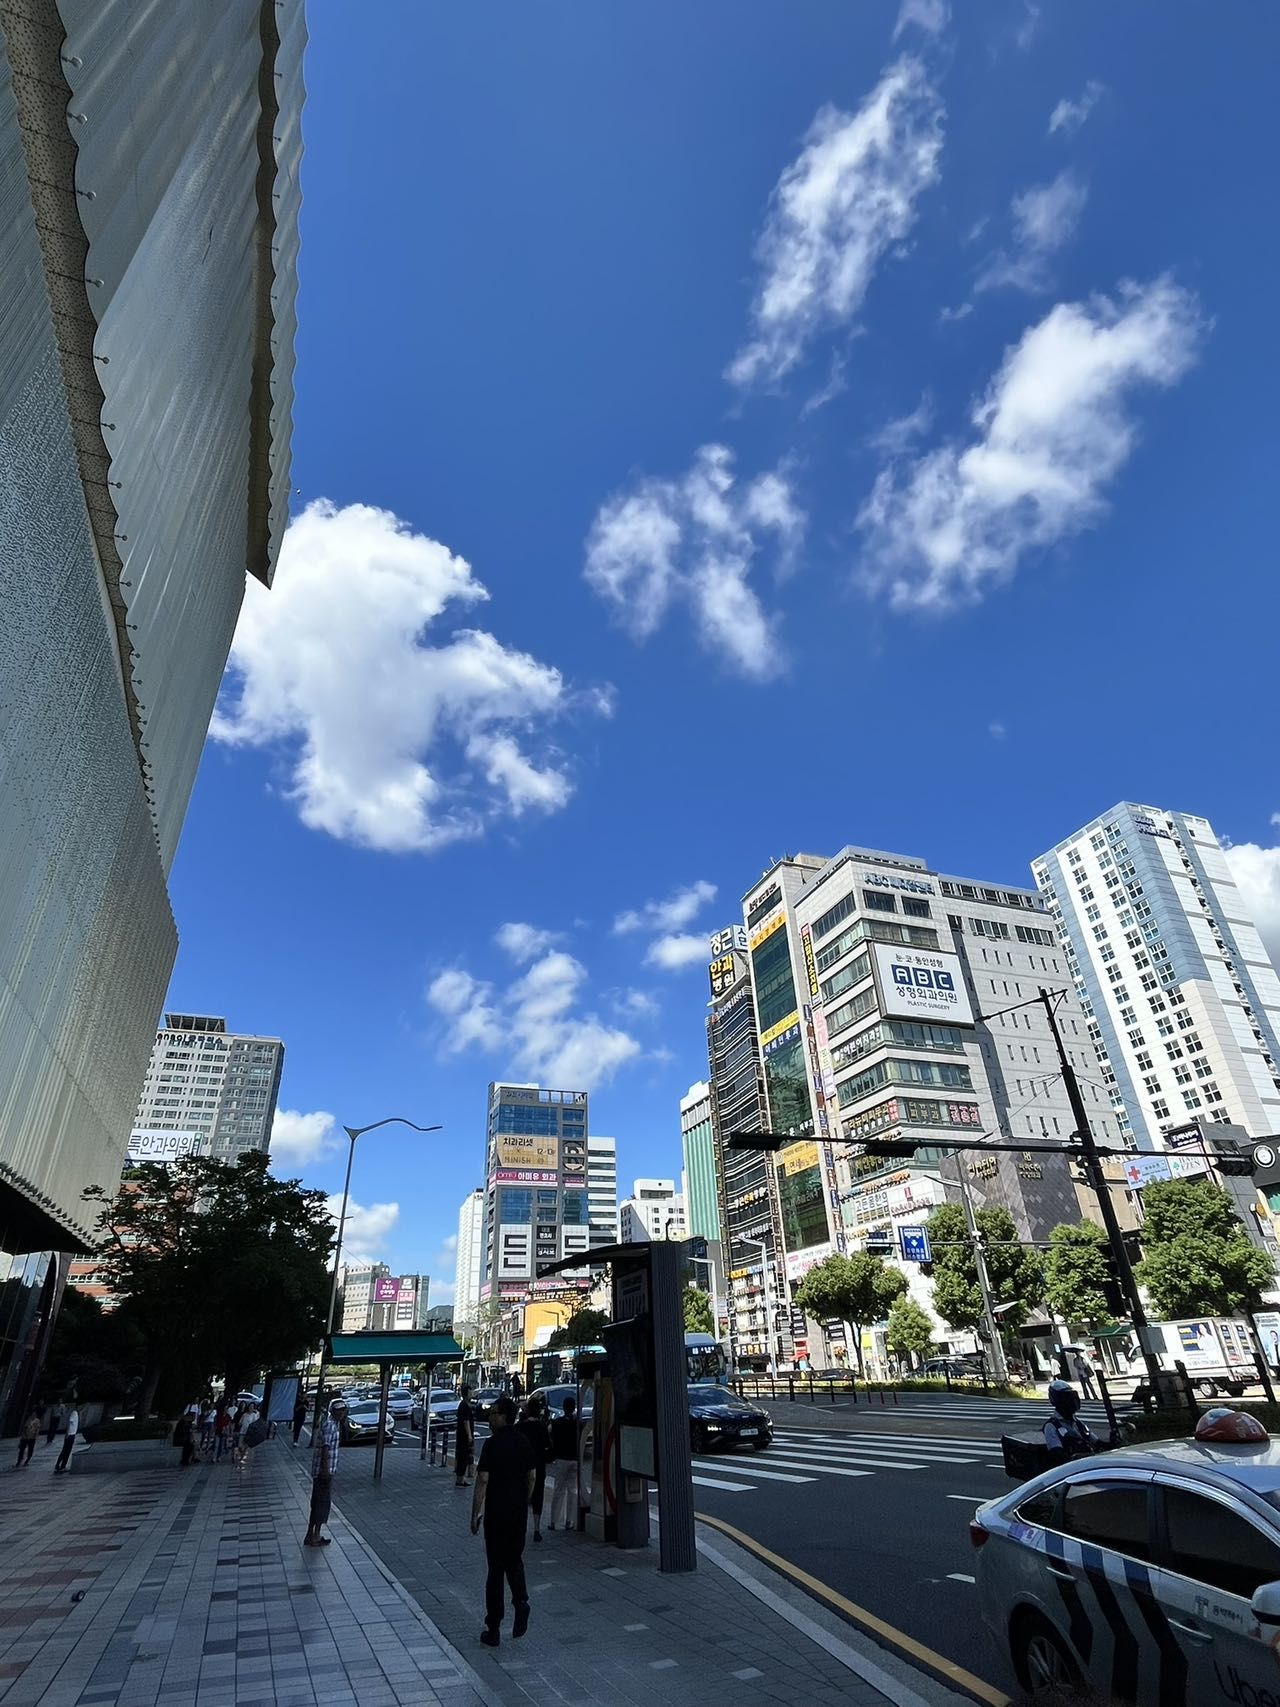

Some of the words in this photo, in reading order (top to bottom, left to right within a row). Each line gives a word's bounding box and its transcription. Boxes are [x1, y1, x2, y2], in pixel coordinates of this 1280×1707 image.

[711, 927, 733, 955] 정근
[711, 953, 733, 979] 안과
[713, 971, 734, 991] 병원
[896, 967, 951, 988] ABC
[895, 985, 958, 1004] 성형외과의원
[907, 1000, 927, 1009] PLASTIC
[928, 1002, 950, 1010] SURGERY
[503, 1137, 533, 1146] 치과리셋
[518, 1172, 539, 1180] 아미유
[542, 1173, 556, 1181] 외과
[1213, 1659, 1280, 1707] Ube
